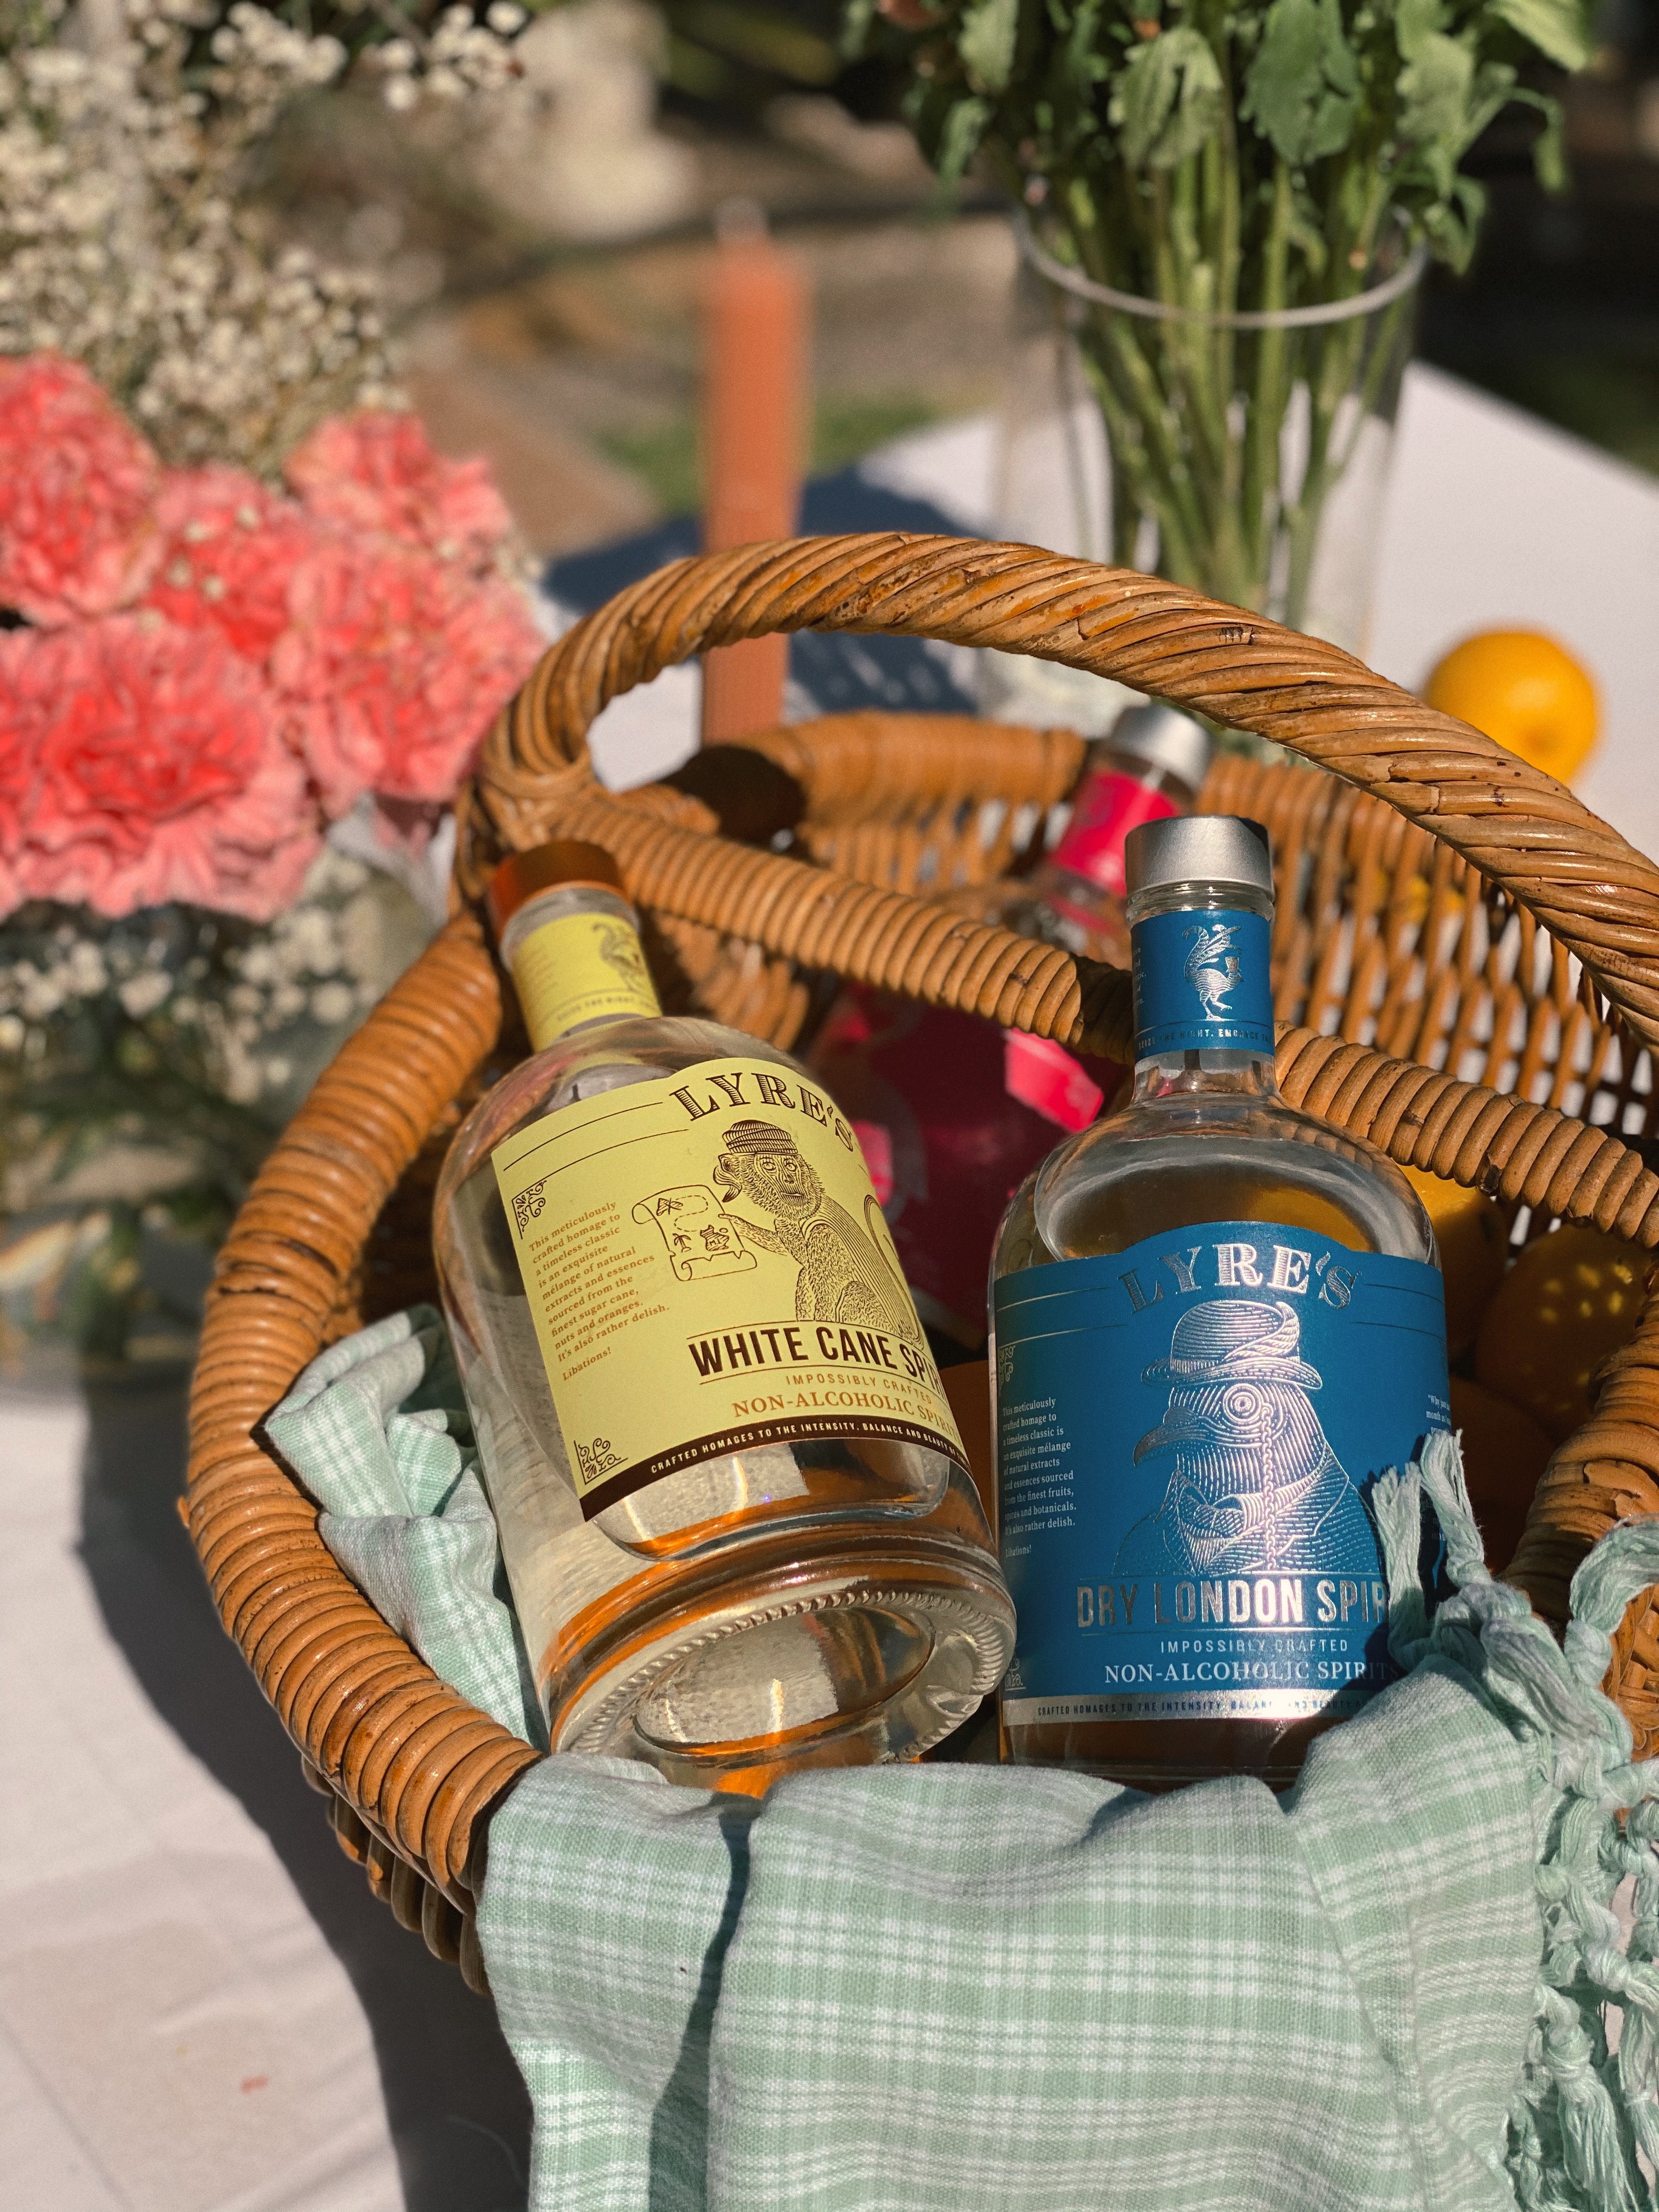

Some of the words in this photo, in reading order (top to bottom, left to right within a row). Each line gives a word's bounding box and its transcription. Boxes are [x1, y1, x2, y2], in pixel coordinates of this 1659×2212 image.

[669, 1071, 854, 1152] LYRE'S
[529, 1236, 549, 1251] This
[551, 1201, 616, 1238] meticulously
[533, 1238, 565, 1263] crafted
[567, 1220, 607, 1243] homage
[610, 1214, 620, 1222] to
[539, 1279, 547, 1288] is
[549, 1270, 561, 1282] an
[562, 1245, 608, 1273] exquisite
[543, 1244, 583, 1271] timeless
[585, 1226, 620, 1247] classic
[542, 1273, 581, 1300] mélange
[584, 1263, 595, 1274] of
[597, 1246, 636, 1269] natural
[545, 1285, 583, 1312] extracts
[585, 1274, 604, 1288] and
[607, 1254, 655, 1278] essences
[1117, 1243, 1361, 1314] LYRE'S
[549, 1296, 585, 1325] sourced
[588, 1284, 613, 1301] from
[616, 1275, 633, 1286] the
[551, 1316, 577, 1338] finest
[579, 1300, 607, 1320] sugar
[610, 1289, 639, 1304] cane,
[555, 1332, 575, 1350] nuts
[577, 1320, 596, 1335] and
[598, 1300, 644, 1324] oranges.
[557, 1348, 572, 1362] It's
[574, 1336, 594, 1352] also
[596, 1318, 629, 1339] rather
[632, 1304, 670, 1323] delish.
[562, 1346, 612, 1381] Libations!
[688, 1327, 809, 1376] WHITE
[816, 1327, 898, 1370] CANE
[732, 1391, 915, 1418] NON-ALCOHOLIC
[786, 1373, 876, 1387] IMPOSSIBLY
[883, 1379, 932, 1404] CRAFTED
[1002, 1407, 1013, 1417] This
[1013, 1397, 1056, 1414] meticulously
[1006, 1433, 1029, 1446] timeless
[1030, 1427, 1054, 1440] classic
[1056, 1426, 1064, 1435] is
[1021, 1415, 1047, 1426] homage
[1048, 1413, 1057, 1421] to
[651, 1448, 698, 1474] CRAFTED
[702, 1432, 754, 1453] HOMAGES
[758, 1429, 772, 1438] TO
[776, 1425, 797, 1435] THE
[862, 1422, 904, 1435] BALANCE
[906, 1428, 922, 1438] AND
[923, 1433, 948, 1451] BEAUTY
[1009, 1461, 1029, 1474] natural
[1030, 1458, 1060, 1470] extracts
[1010, 1445, 1036, 1460] exquisite
[1037, 1441, 1071, 1453] mélange
[1013, 1475, 1040, 1488] essences
[1042, 1470, 1074, 1483] sourced
[1017, 1493, 1026, 1503] the
[1028, 1489, 1047, 1500] finest
[1048, 1486, 1074, 1497] fruits,
[1013, 1523, 1024, 1534] also
[1025, 1520, 1046, 1532] rather
[1047, 1516, 1075, 1528] delish.
[1021, 1506, 1032, 1517] and
[1034, 1501, 1076, 1515] botanicals.
[1077, 1583, 1138, 1628] DRY
[1154, 1578, 1304, 1624] LONDON
[1161, 1639, 1265, 1654] IMPOSSIBLY
[1274, 1639, 1347, 1652] CRAFTED
[1105, 1661, 1309, 1683] NON-ALCOHOLIC
[1038, 1705, 1070, 1716] CRAFTED
[1074, 1703, 1116, 1715] HOMAGES
[1121, 1702, 1132, 1712] TO
[1138, 1702, 1156, 1712] THE
